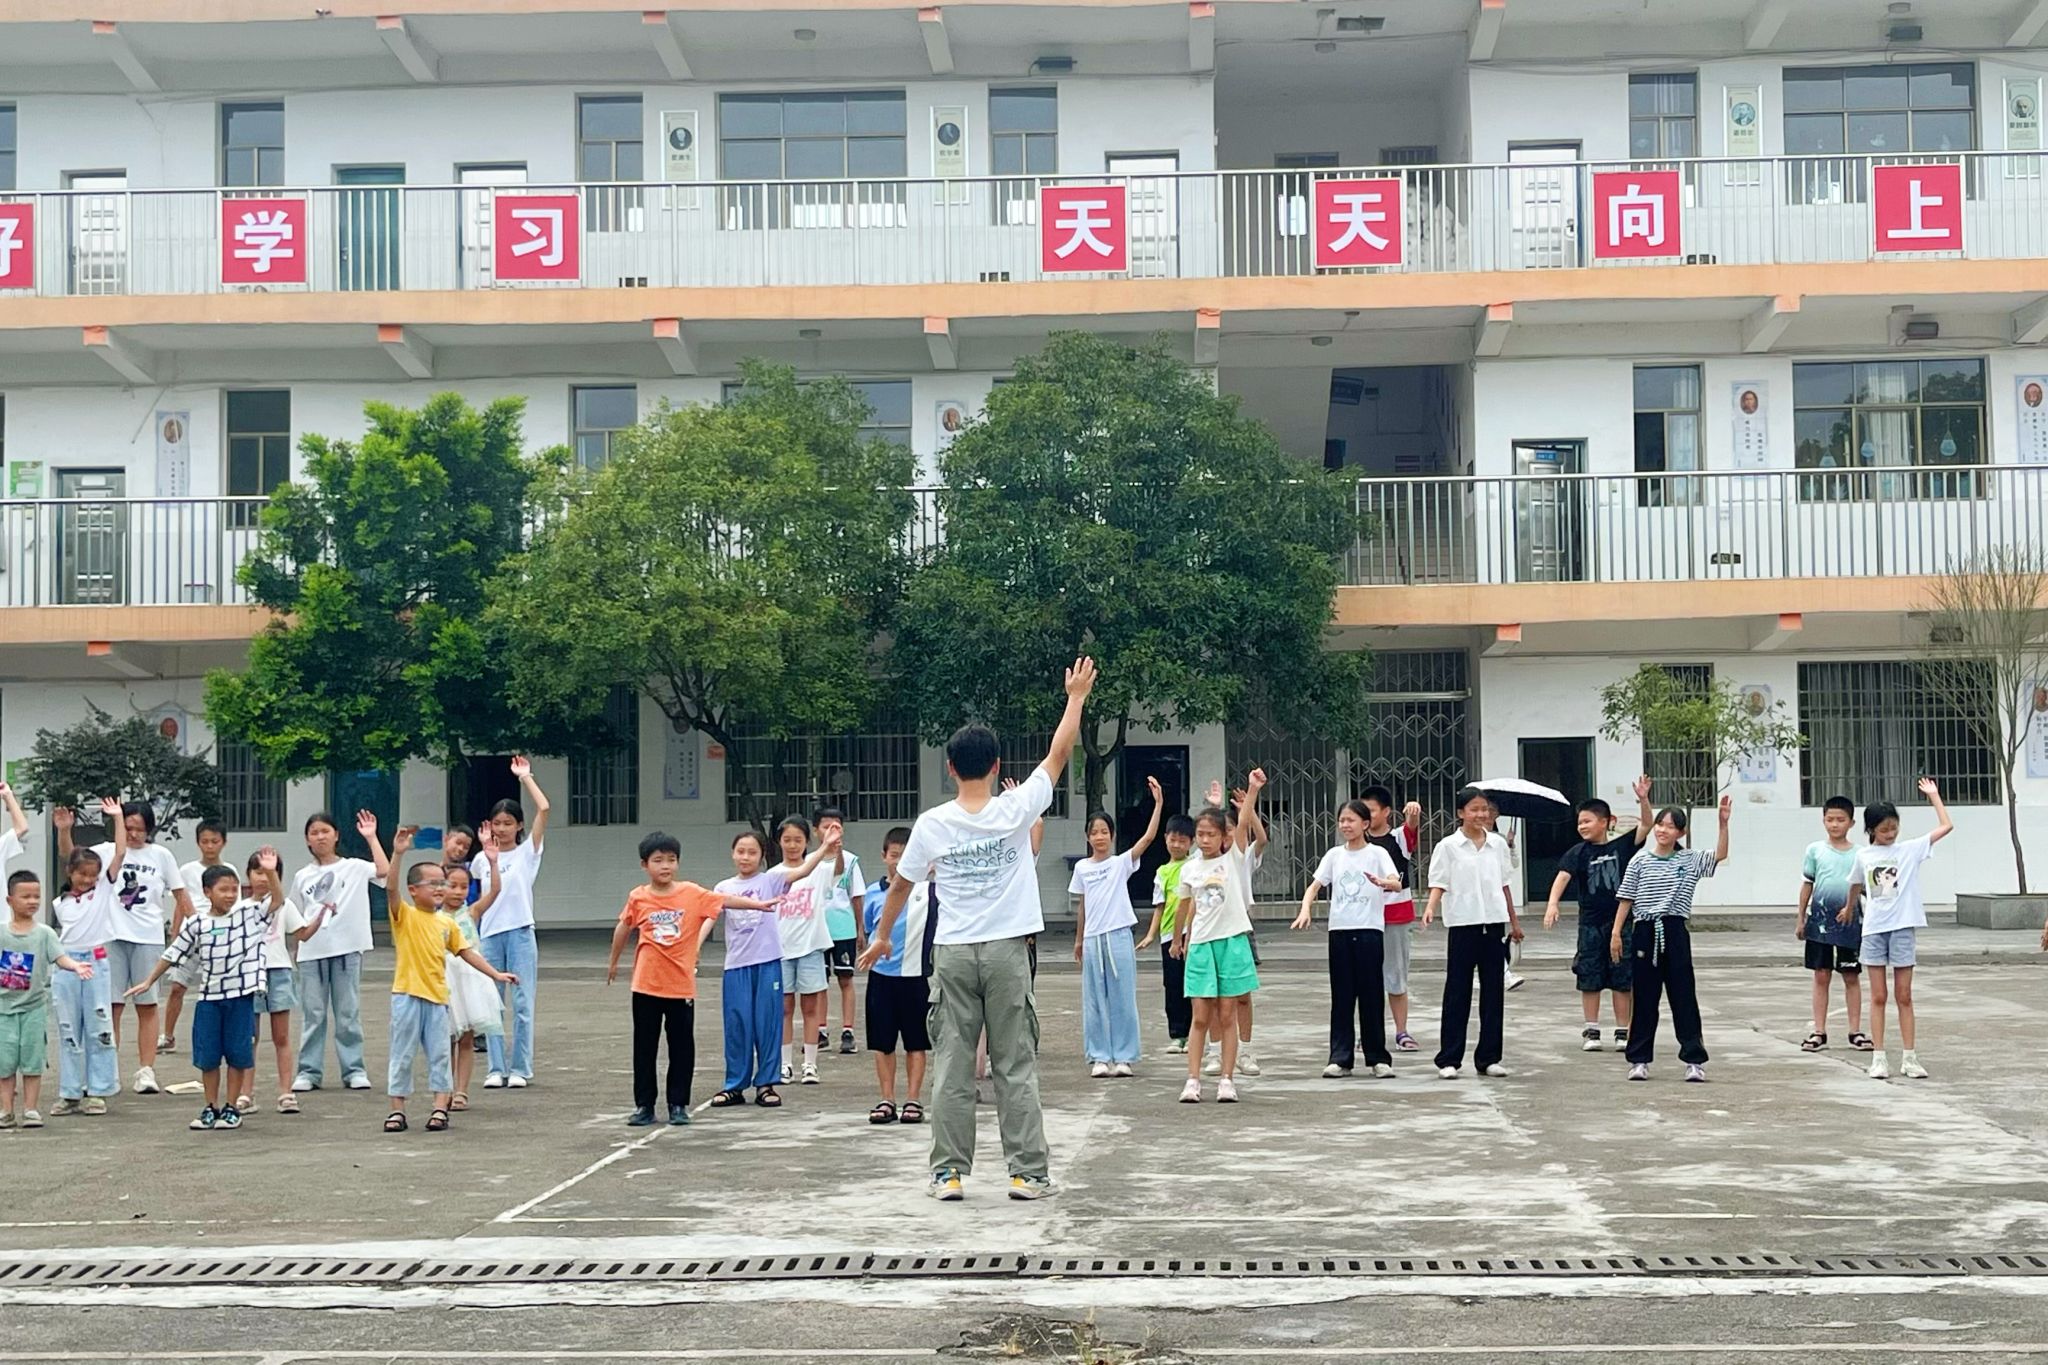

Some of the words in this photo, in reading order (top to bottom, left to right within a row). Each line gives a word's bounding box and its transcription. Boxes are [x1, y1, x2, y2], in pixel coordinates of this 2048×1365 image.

[234, 210, 294, 273] 学
[511, 208, 563, 266] 习
[1054, 200, 1114, 259] 天
[1328, 193, 1389, 253] 天
[1608, 184, 1665, 246] 向
[1887, 179, 1950, 239] 上
